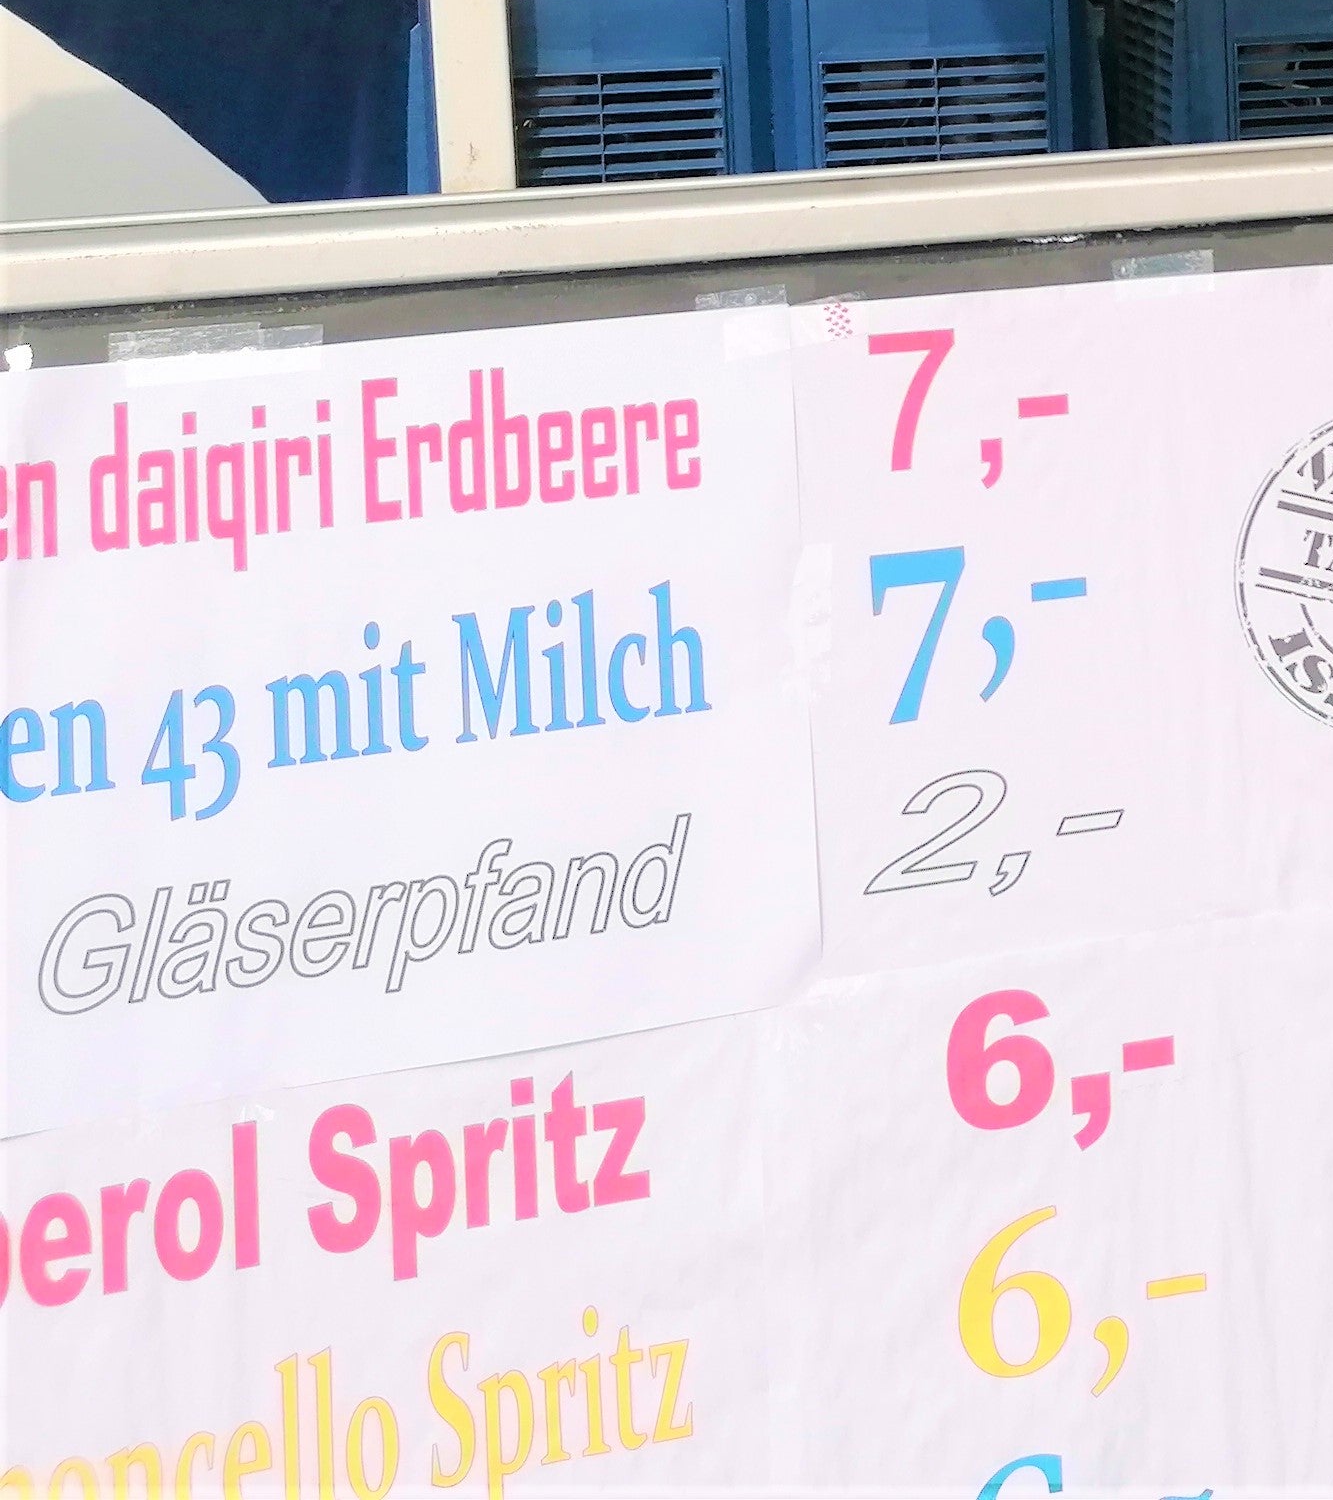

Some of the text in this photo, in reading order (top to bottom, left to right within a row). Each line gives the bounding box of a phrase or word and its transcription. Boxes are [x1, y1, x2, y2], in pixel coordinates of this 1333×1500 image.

[90, 400, 335, 572] daiqiri
[361, 367, 702, 525] Erdbeere
[867, 328, 1069, 489] 7,-
[0, 580, 713, 822] en 43 mit Milch
[869, 545, 1088, 725] 7,-
[38, 813, 693, 1015] Gläserpfand
[863, 769, 1125, 896] 2,-
[945, 988, 1176, 1152] 6,-
[0, 1069, 651, 1309] erol Spritz
[957, 1204, 1208, 1399] 6,-
[430, 1307, 695, 1491] Spritz
